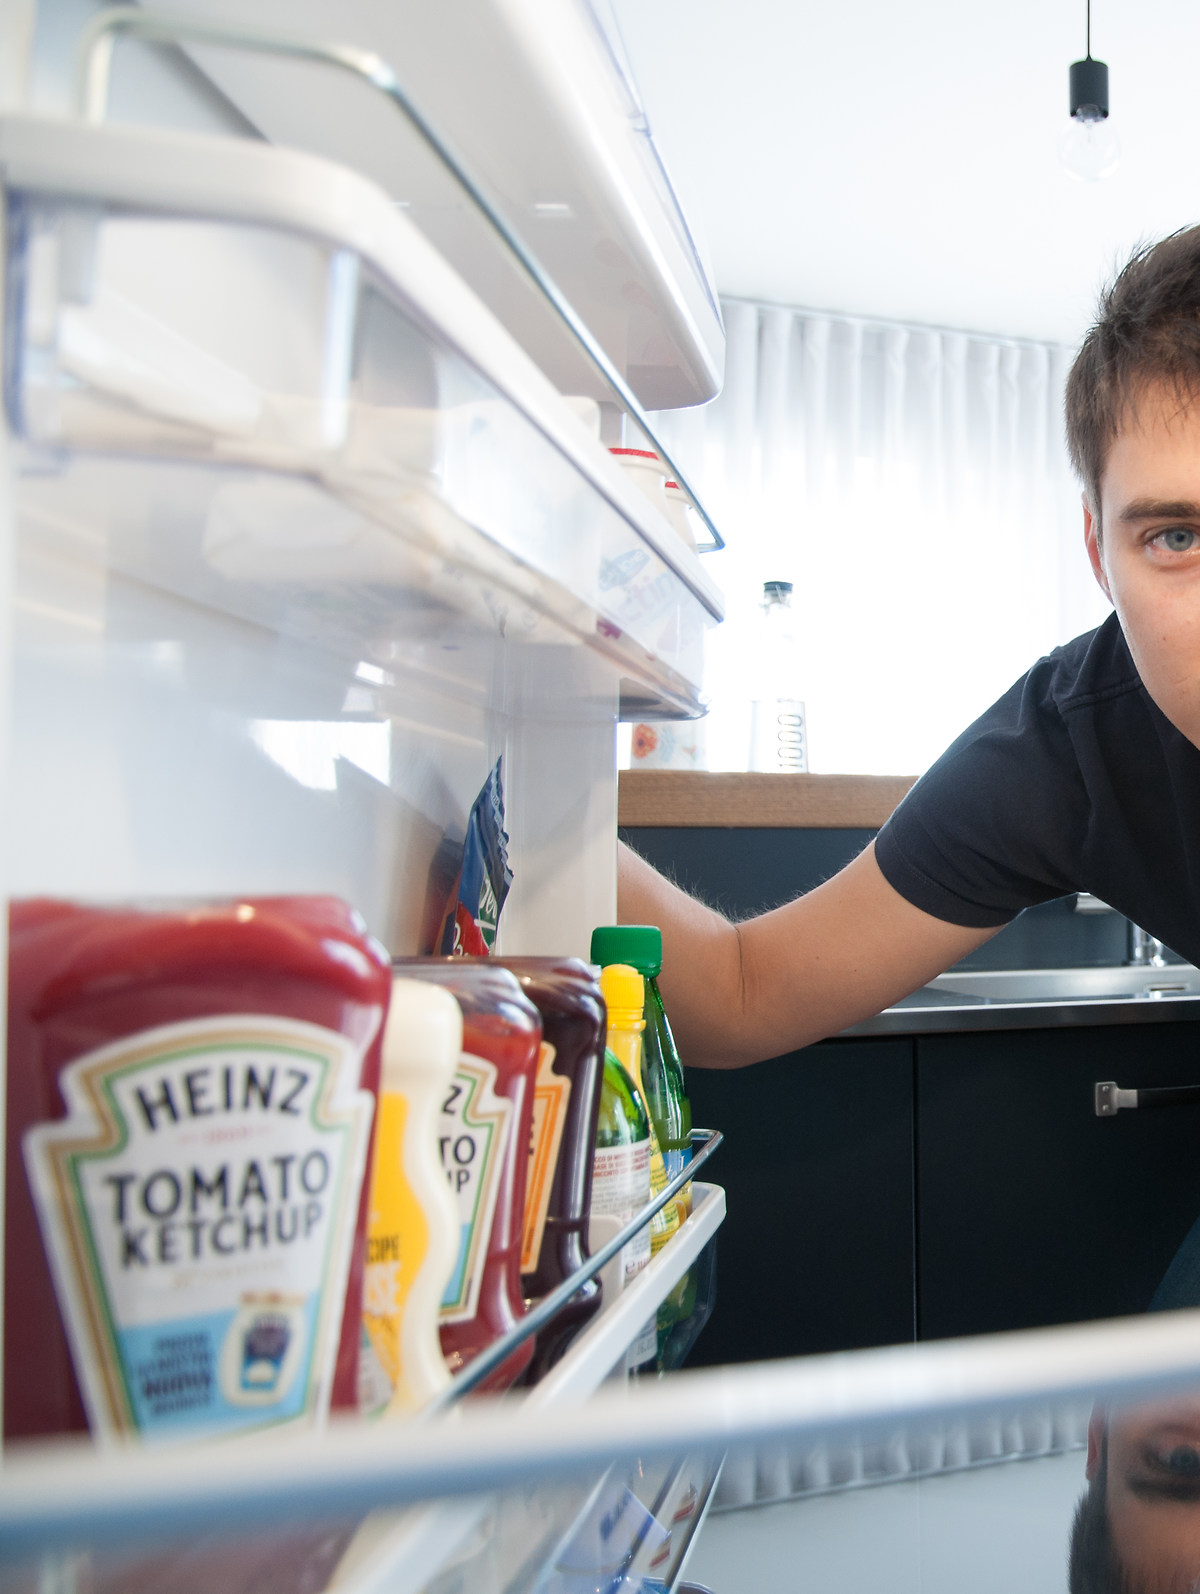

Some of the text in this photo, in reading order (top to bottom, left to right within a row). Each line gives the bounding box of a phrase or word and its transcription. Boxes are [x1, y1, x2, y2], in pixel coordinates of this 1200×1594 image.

[135, 1065, 311, 1132] HEINZ
[437, 1135, 475, 1167] TO
[104, 1149, 330, 1224] TOMATO
[120, 1205, 325, 1270] KETCHUP
